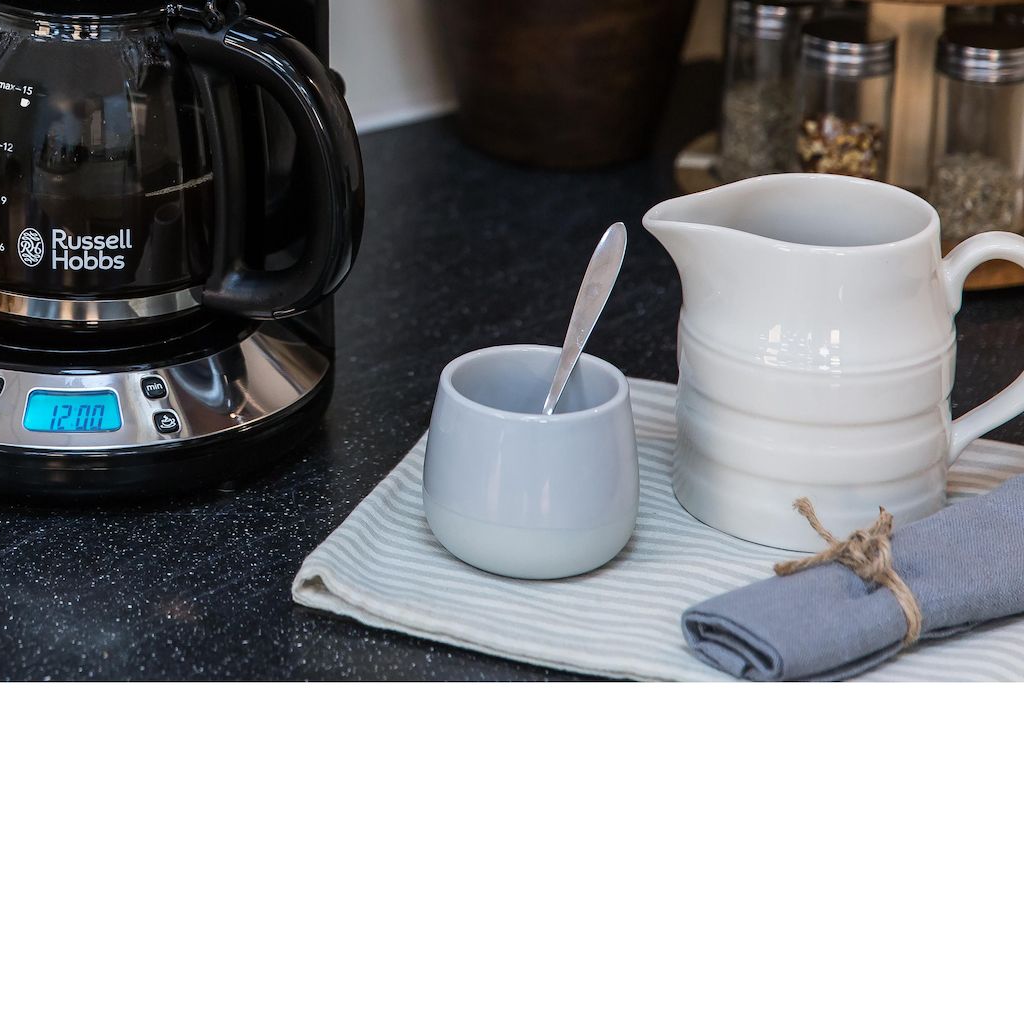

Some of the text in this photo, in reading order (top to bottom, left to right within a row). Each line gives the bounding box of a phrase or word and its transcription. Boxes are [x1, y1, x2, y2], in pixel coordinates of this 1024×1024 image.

[51, 228, 133, 250] Russell
[51, 249, 126, 270] Hobbs
[146, 382, 163, 391] min
[50, 404, 105, 431] 12:00
